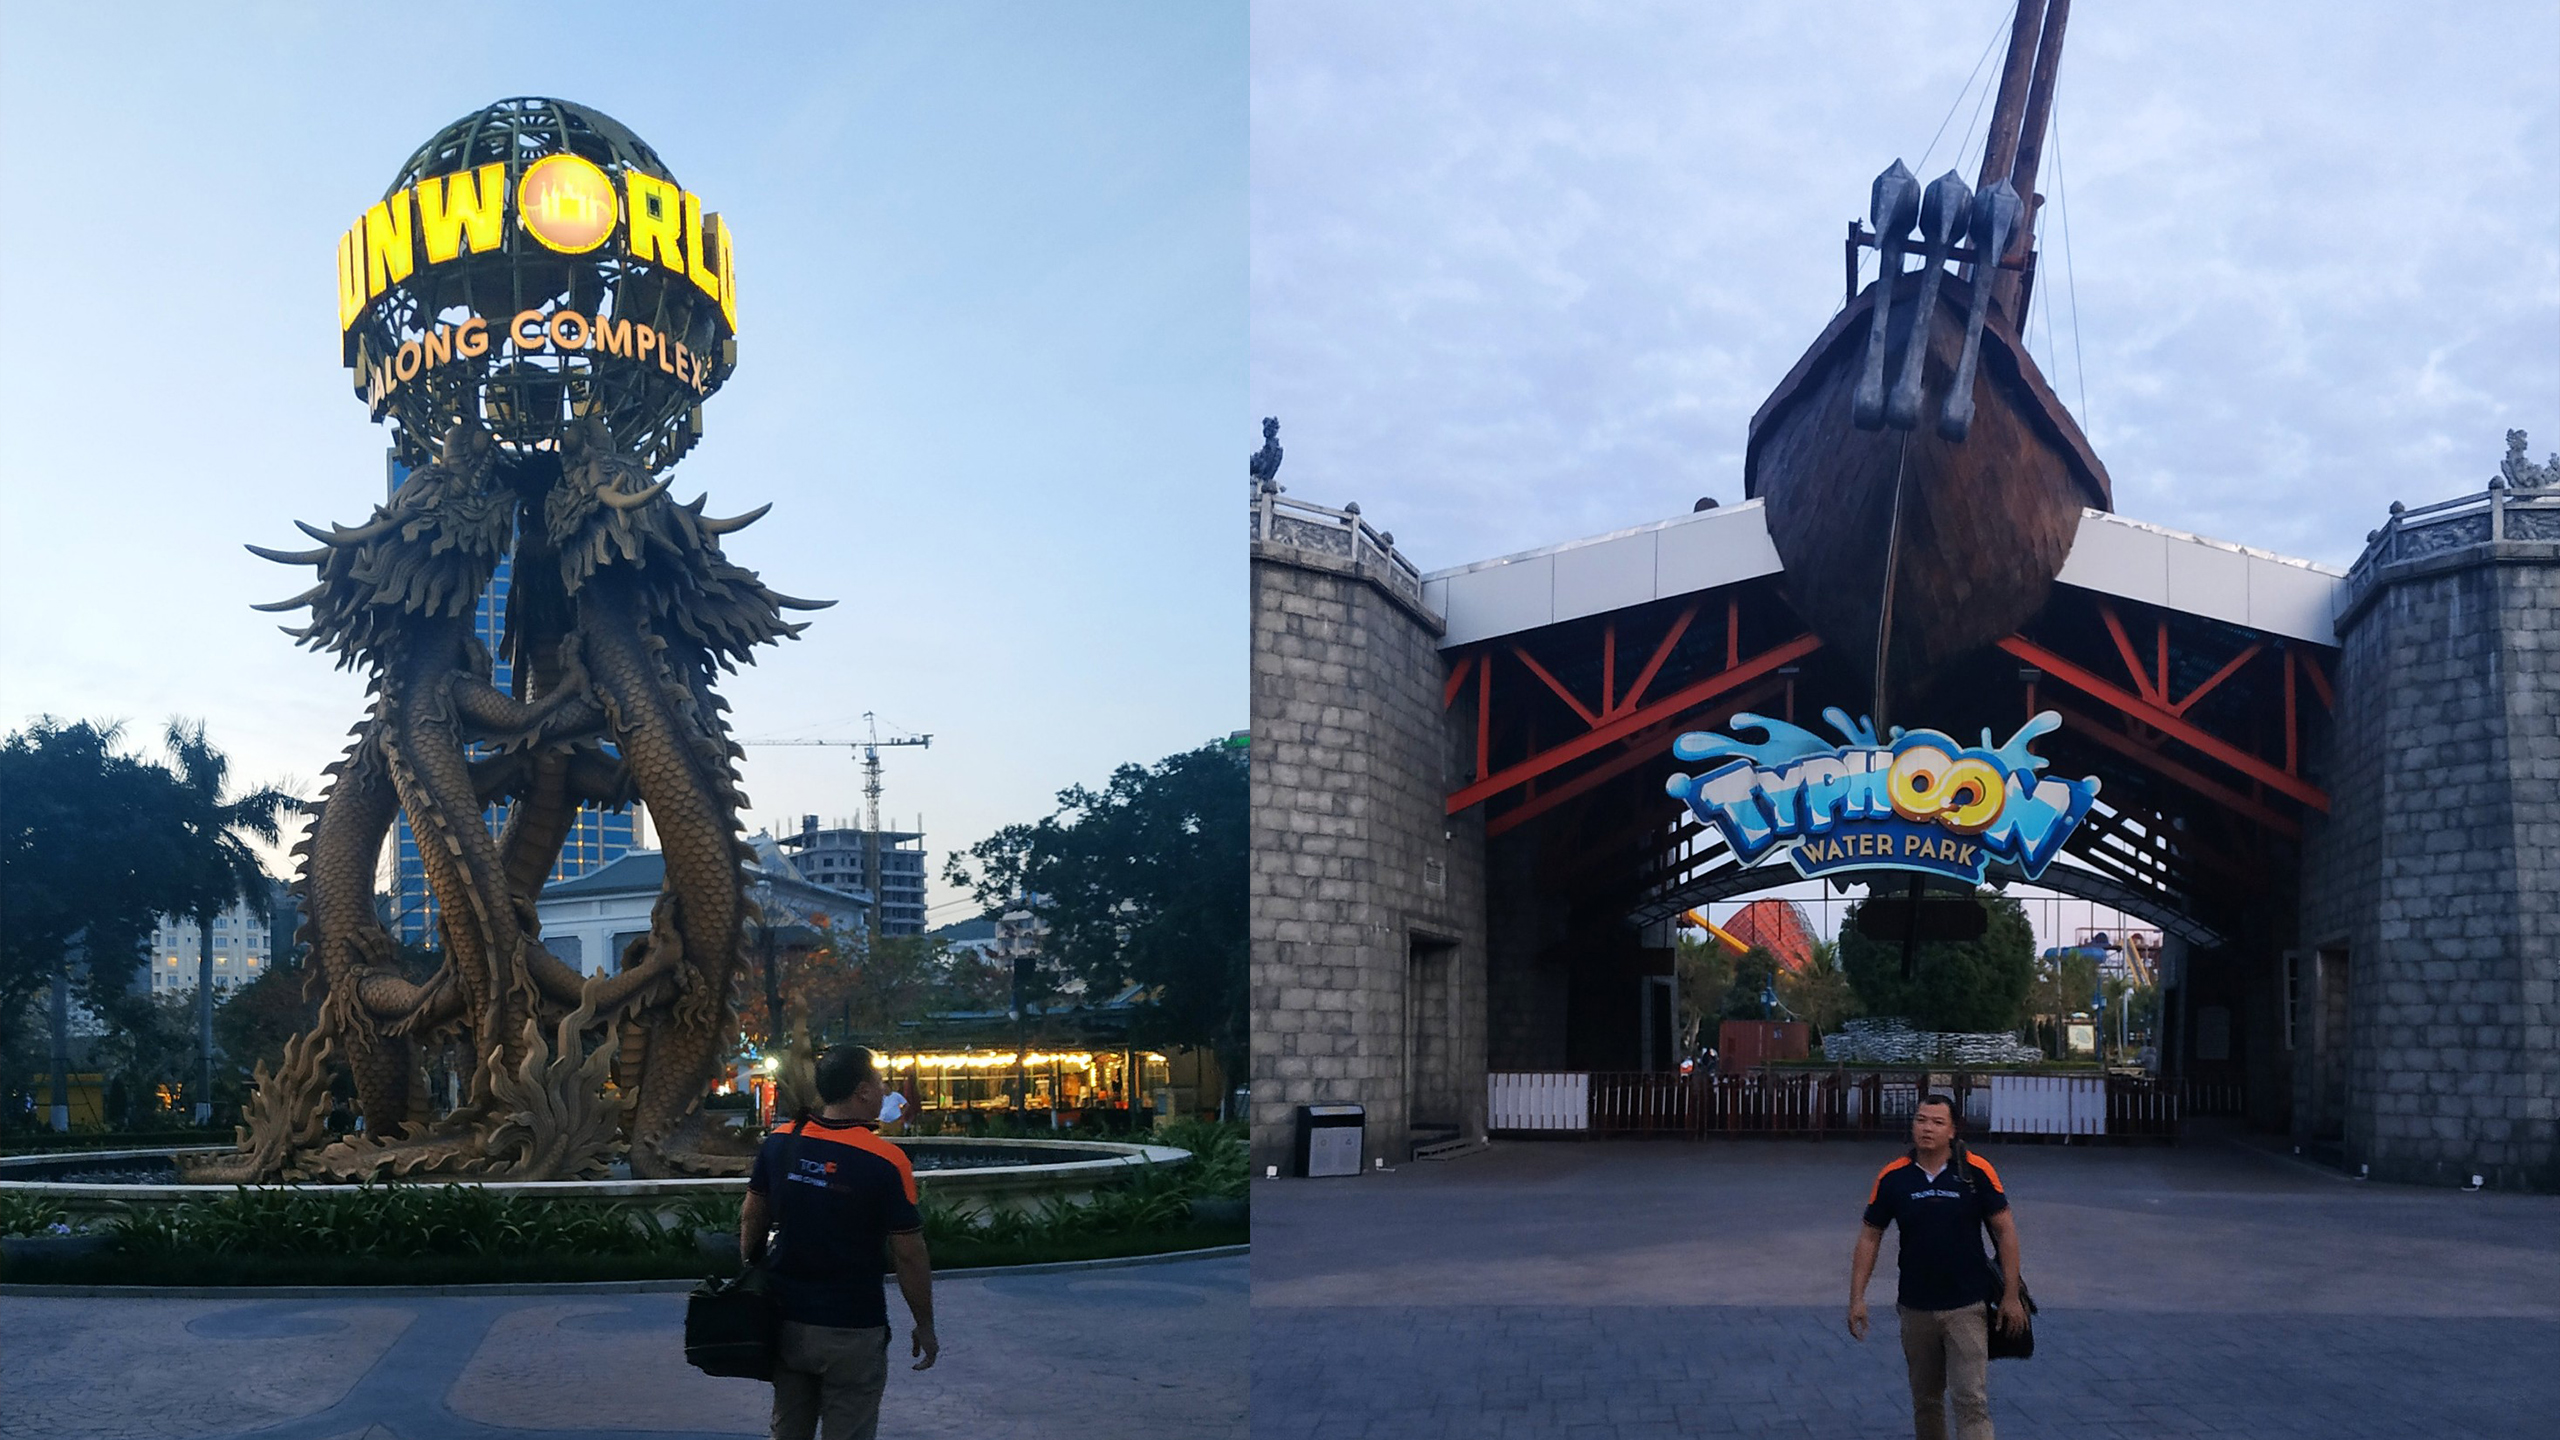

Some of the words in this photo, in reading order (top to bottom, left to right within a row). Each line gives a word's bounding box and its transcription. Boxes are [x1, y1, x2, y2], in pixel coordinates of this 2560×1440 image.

[510, 309, 705, 397] COMPLEX
[1698, 745, 2072, 866] TYPHOON
[1802, 833, 1894, 865] WATER
[1905, 835, 1978, 867] PARK
